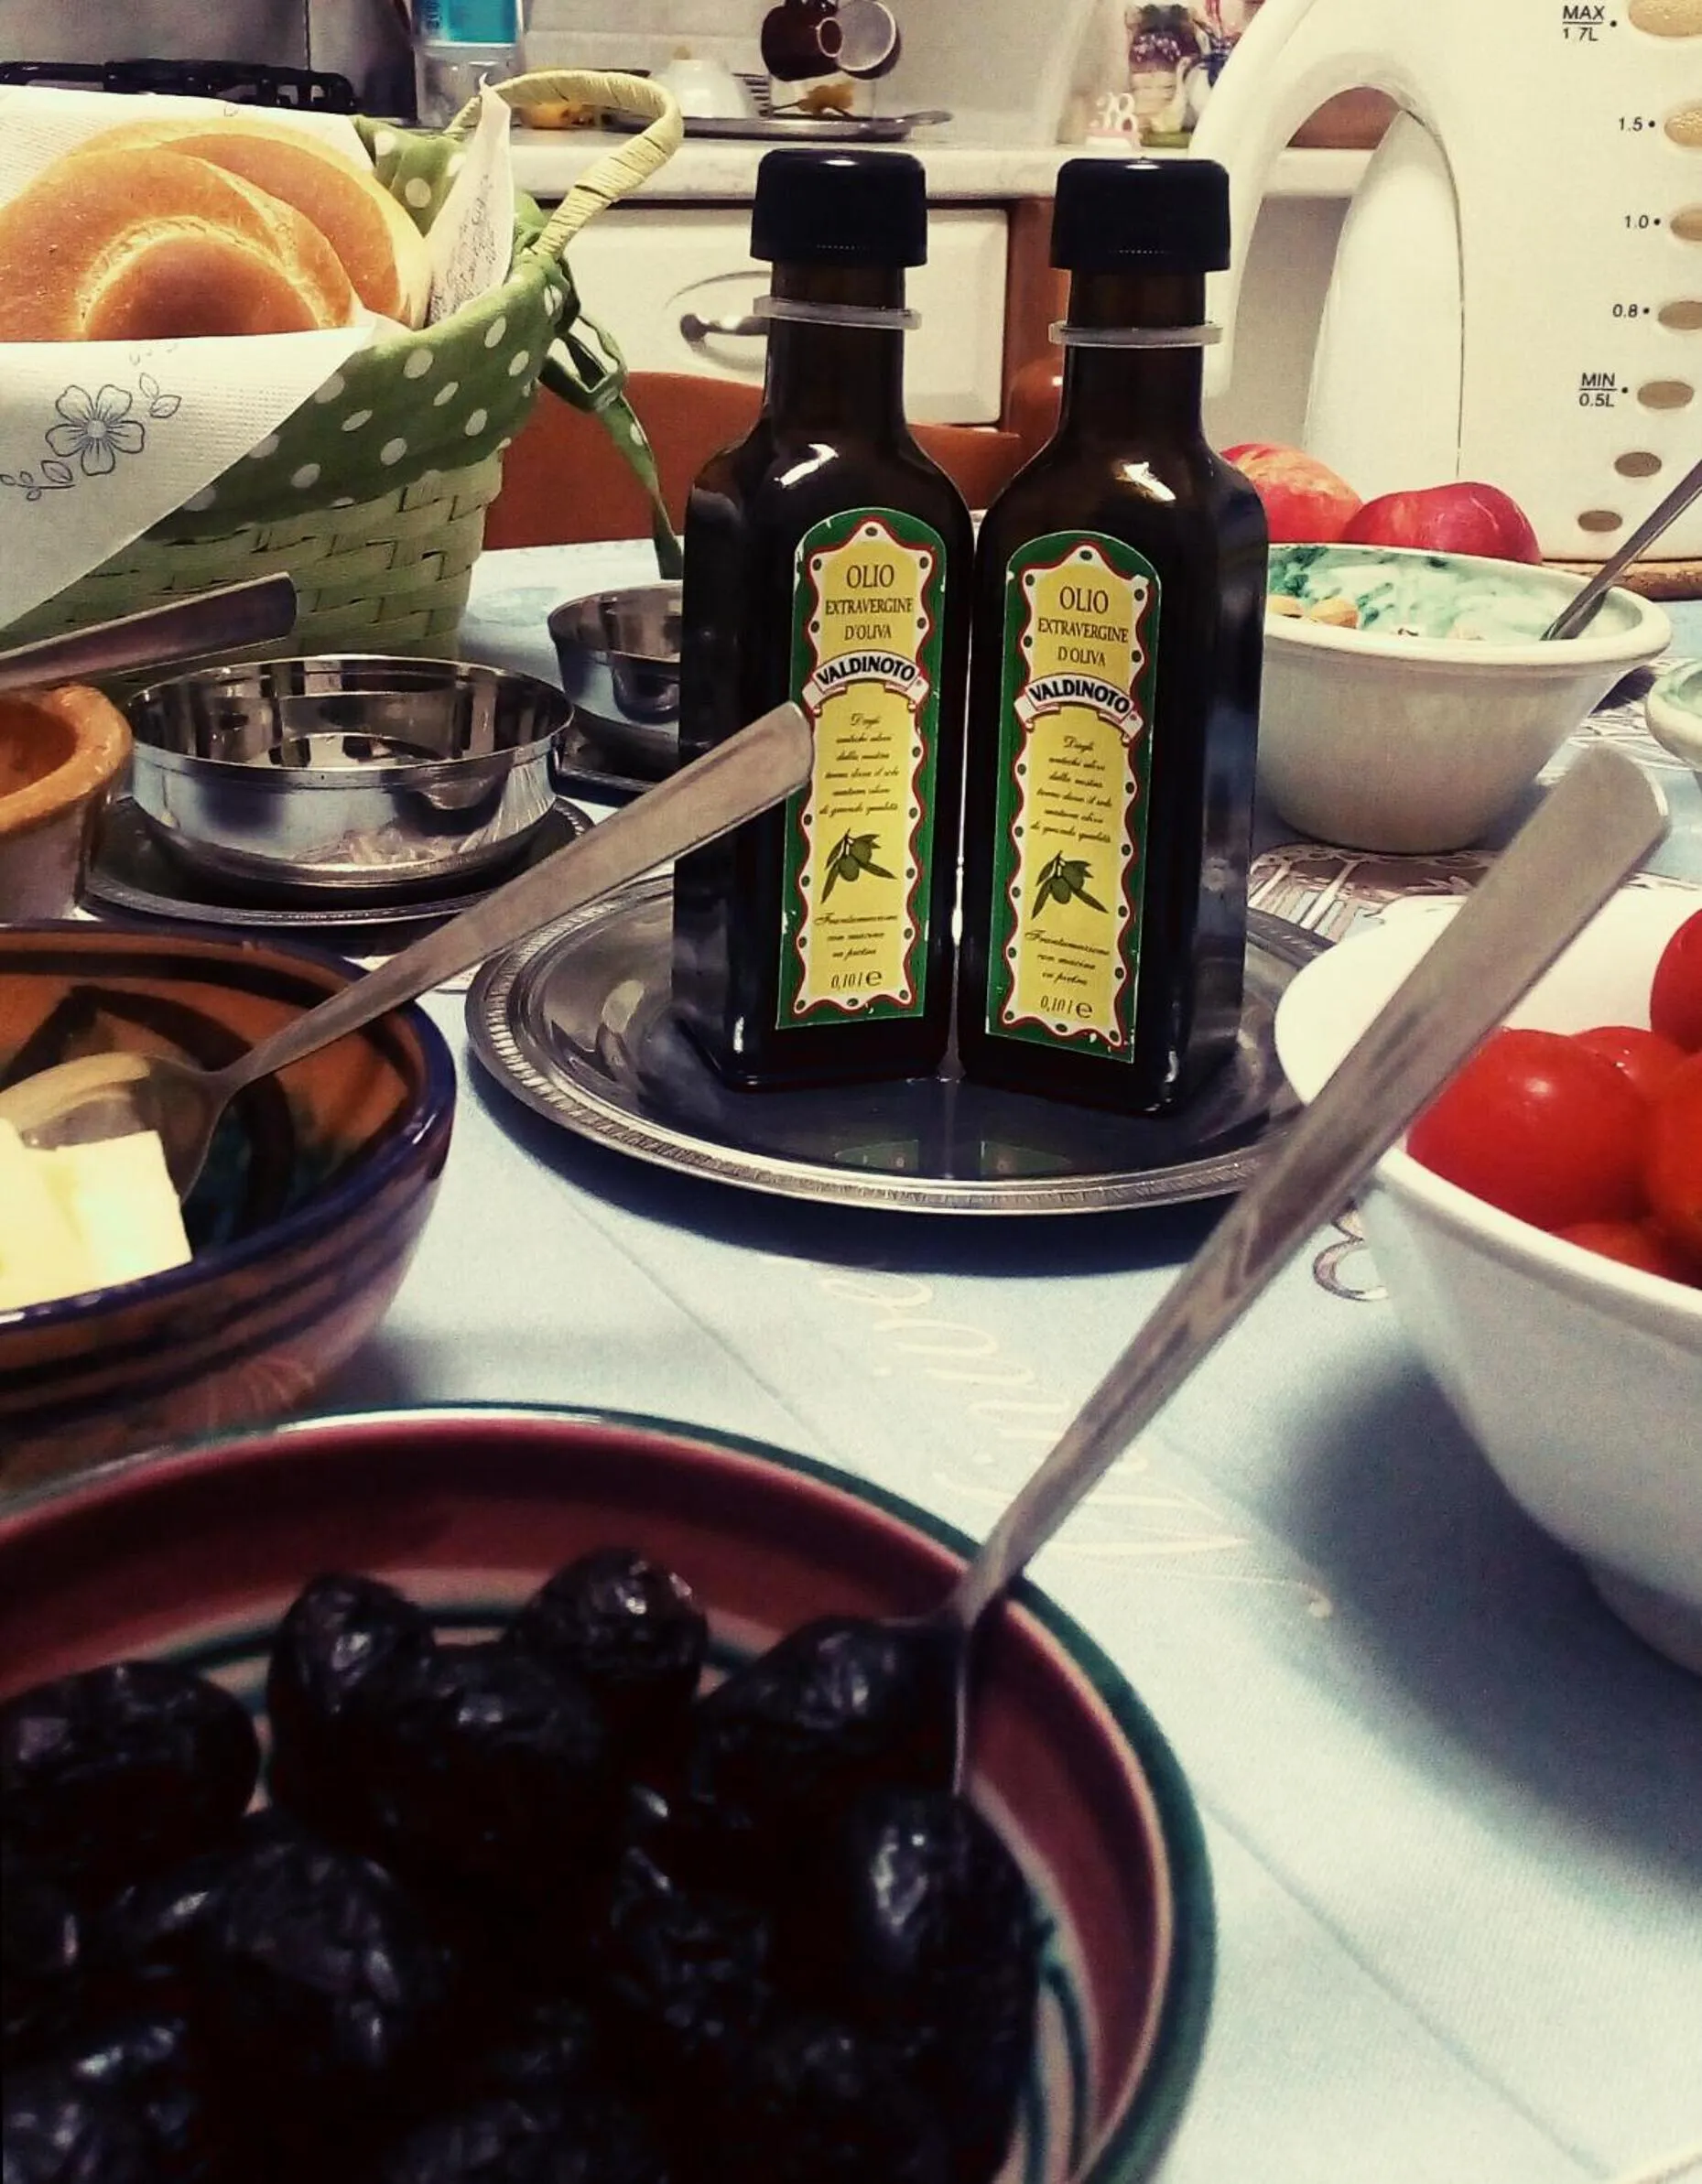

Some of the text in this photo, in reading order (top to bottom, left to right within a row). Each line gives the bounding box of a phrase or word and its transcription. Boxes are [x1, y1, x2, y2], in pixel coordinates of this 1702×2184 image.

[1562, 5, 1605, 20] MAX
[1563, 27, 1599, 41] 17L
[1619, 116, 1643, 132] 1.5
[1624, 215, 1649, 229] 1.0
[1612, 304, 1638, 318] 0.8
[1581, 373, 1616, 386] MIN
[1578, 393, 1615, 407] 0.5L
[846, 564, 894, 589] OLIO
[825, 598, 914, 615] EXTRAVERGINE
[1059, 586, 1110, 614] OLIO
[1037, 617, 1129, 643] EXTRAVERGINE
[1057, 646, 1106, 667] DOLIVA
[816, 655, 916, 686] VALDINOTO
[1029, 679, 1130, 713] VALDINOTO
